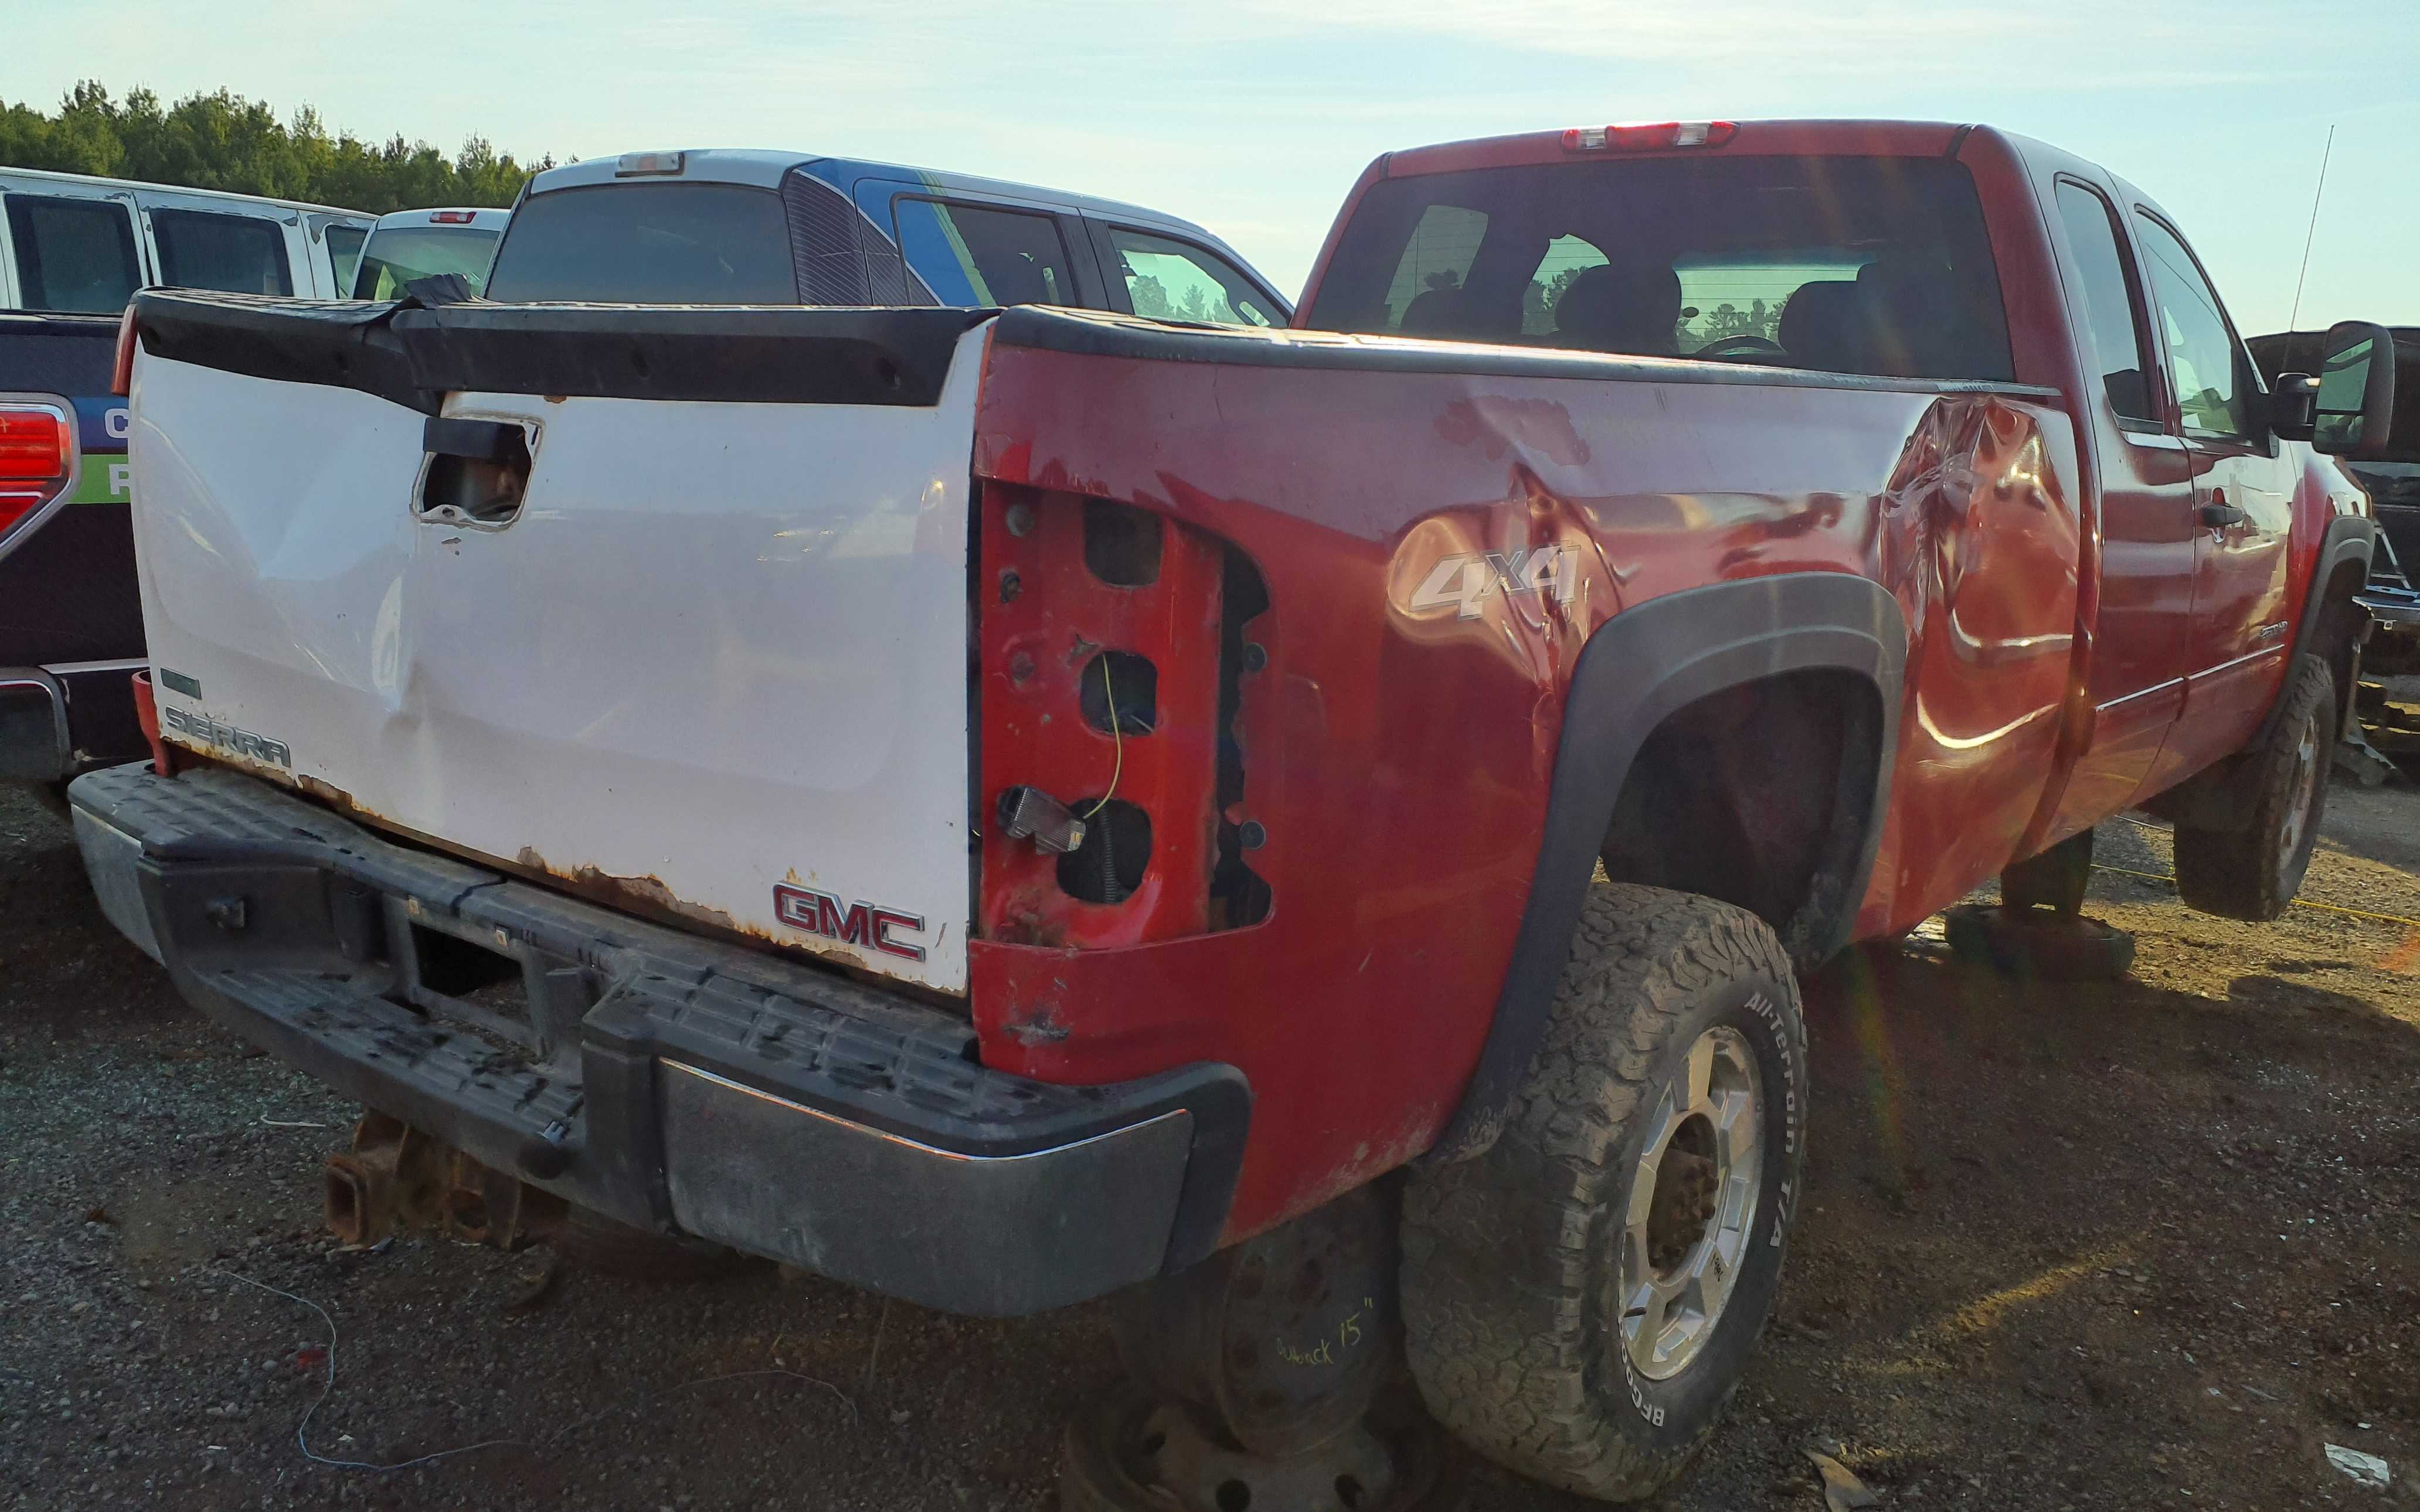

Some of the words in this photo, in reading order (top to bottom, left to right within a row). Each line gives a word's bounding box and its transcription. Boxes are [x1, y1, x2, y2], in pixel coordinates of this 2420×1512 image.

[165, 704, 291, 768] SIERRA
[772, 880, 926, 962] GMC
[1743, 992, 1795, 1153] All-Terrain
[1769, 1179, 1792, 1248] T/A
